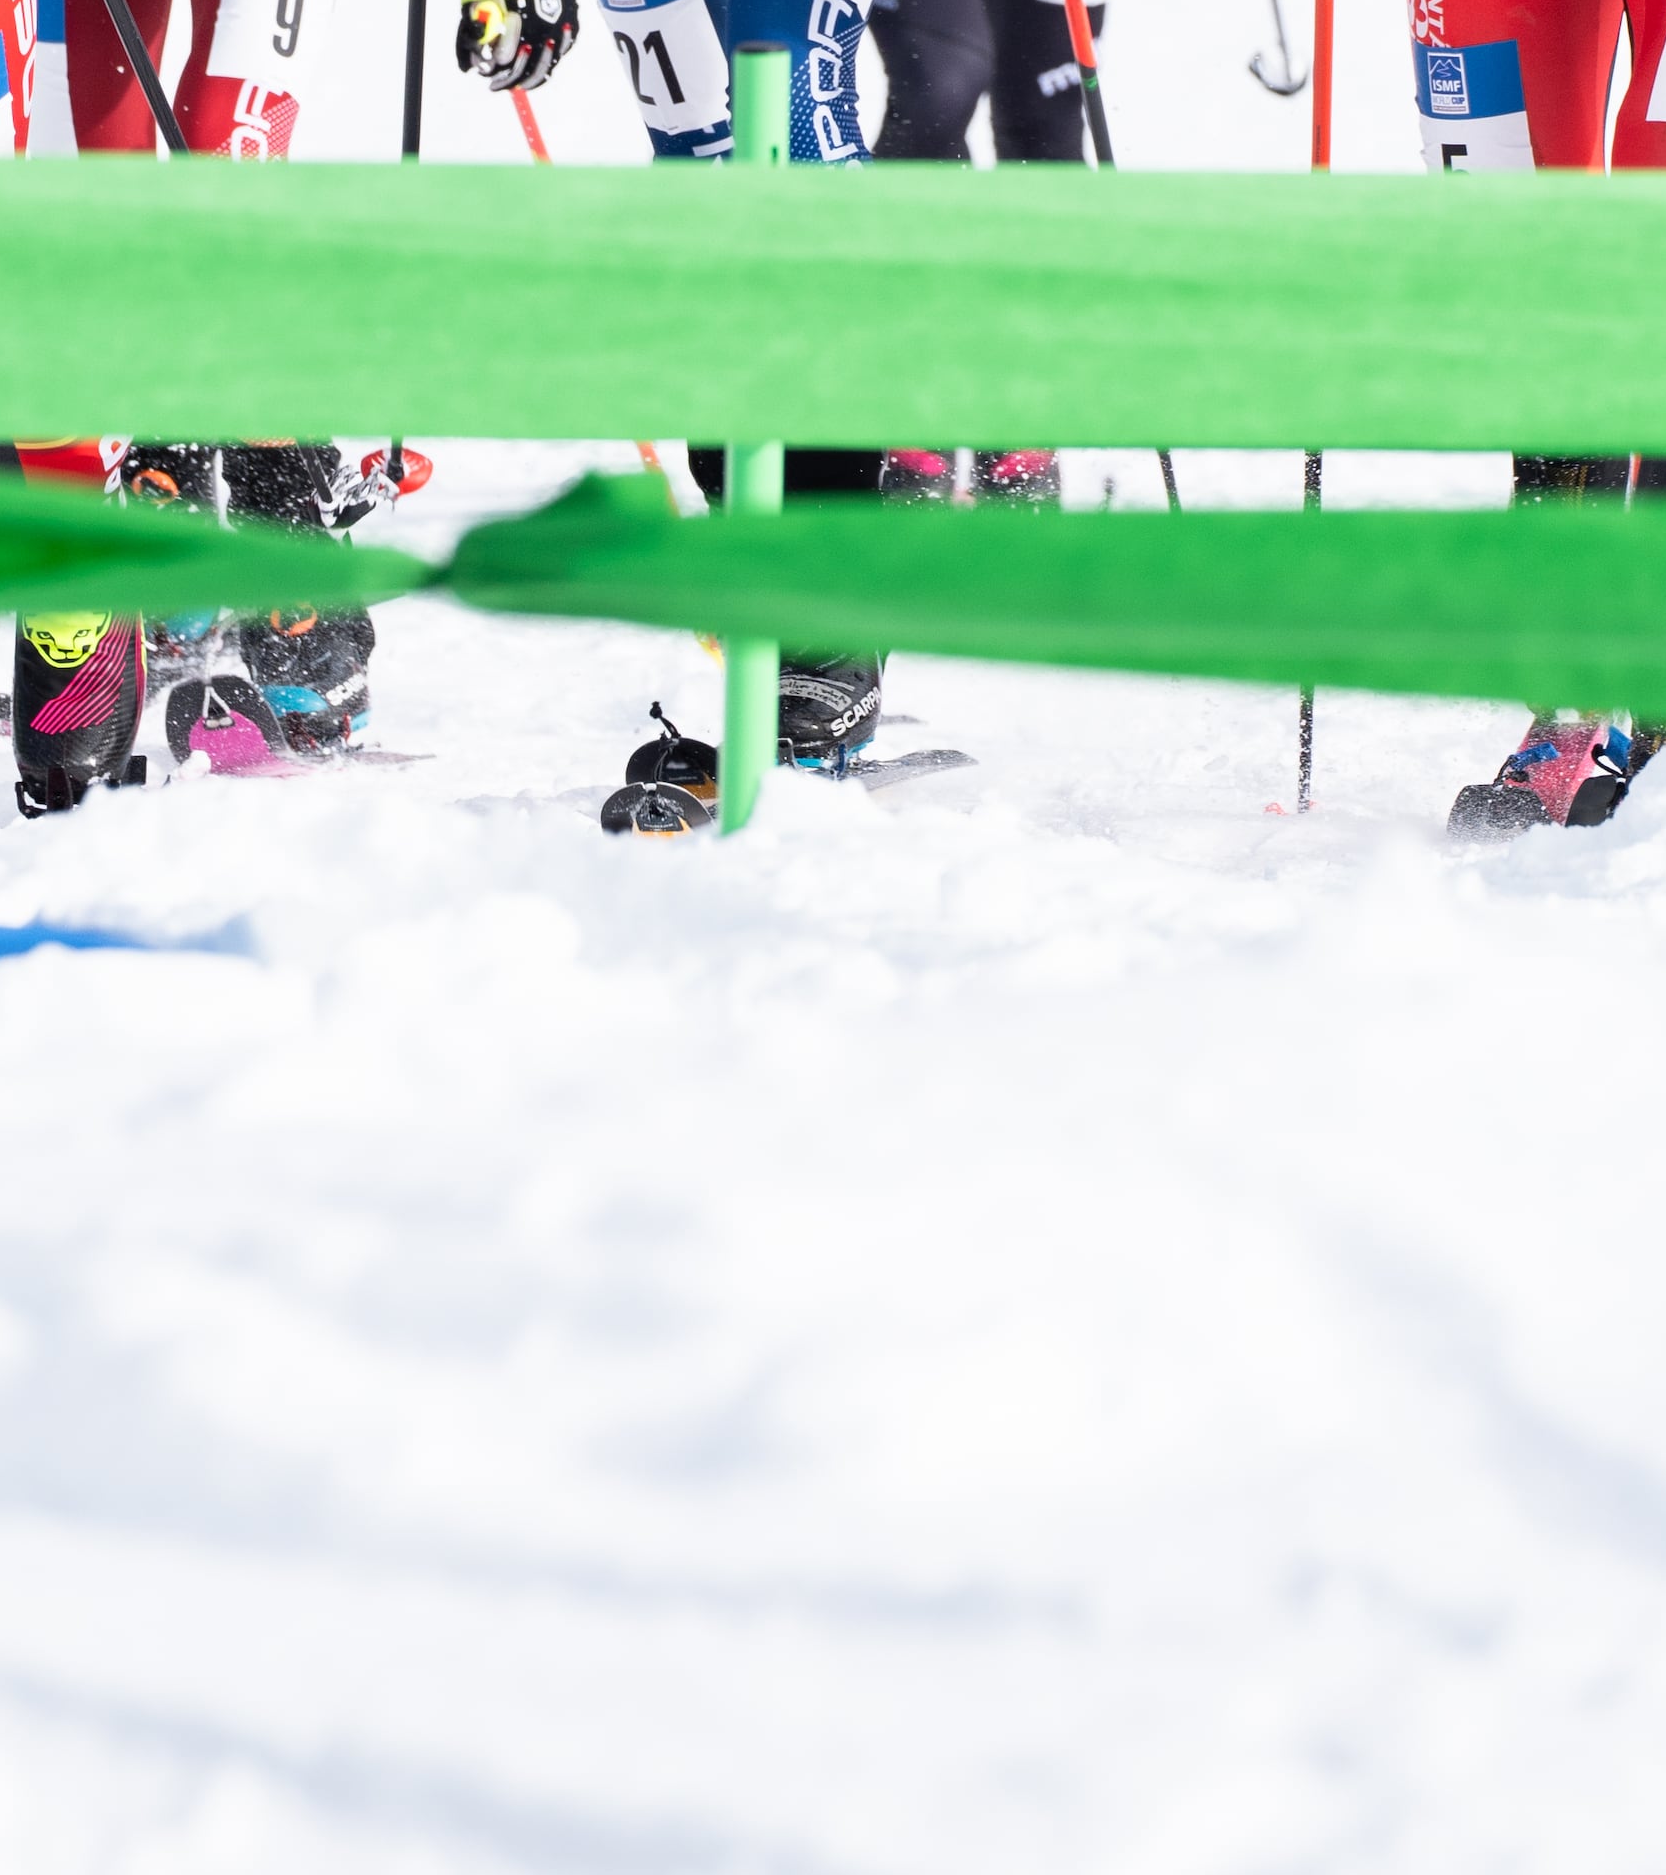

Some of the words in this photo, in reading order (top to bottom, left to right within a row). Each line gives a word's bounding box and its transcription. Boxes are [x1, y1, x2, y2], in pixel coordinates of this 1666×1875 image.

[613, 30, 686, 105] 21
[1433, 79, 1462, 93] ISMF
[1451, 96, 1465, 105] CUP
[829, 685, 882, 737] SCARPA
